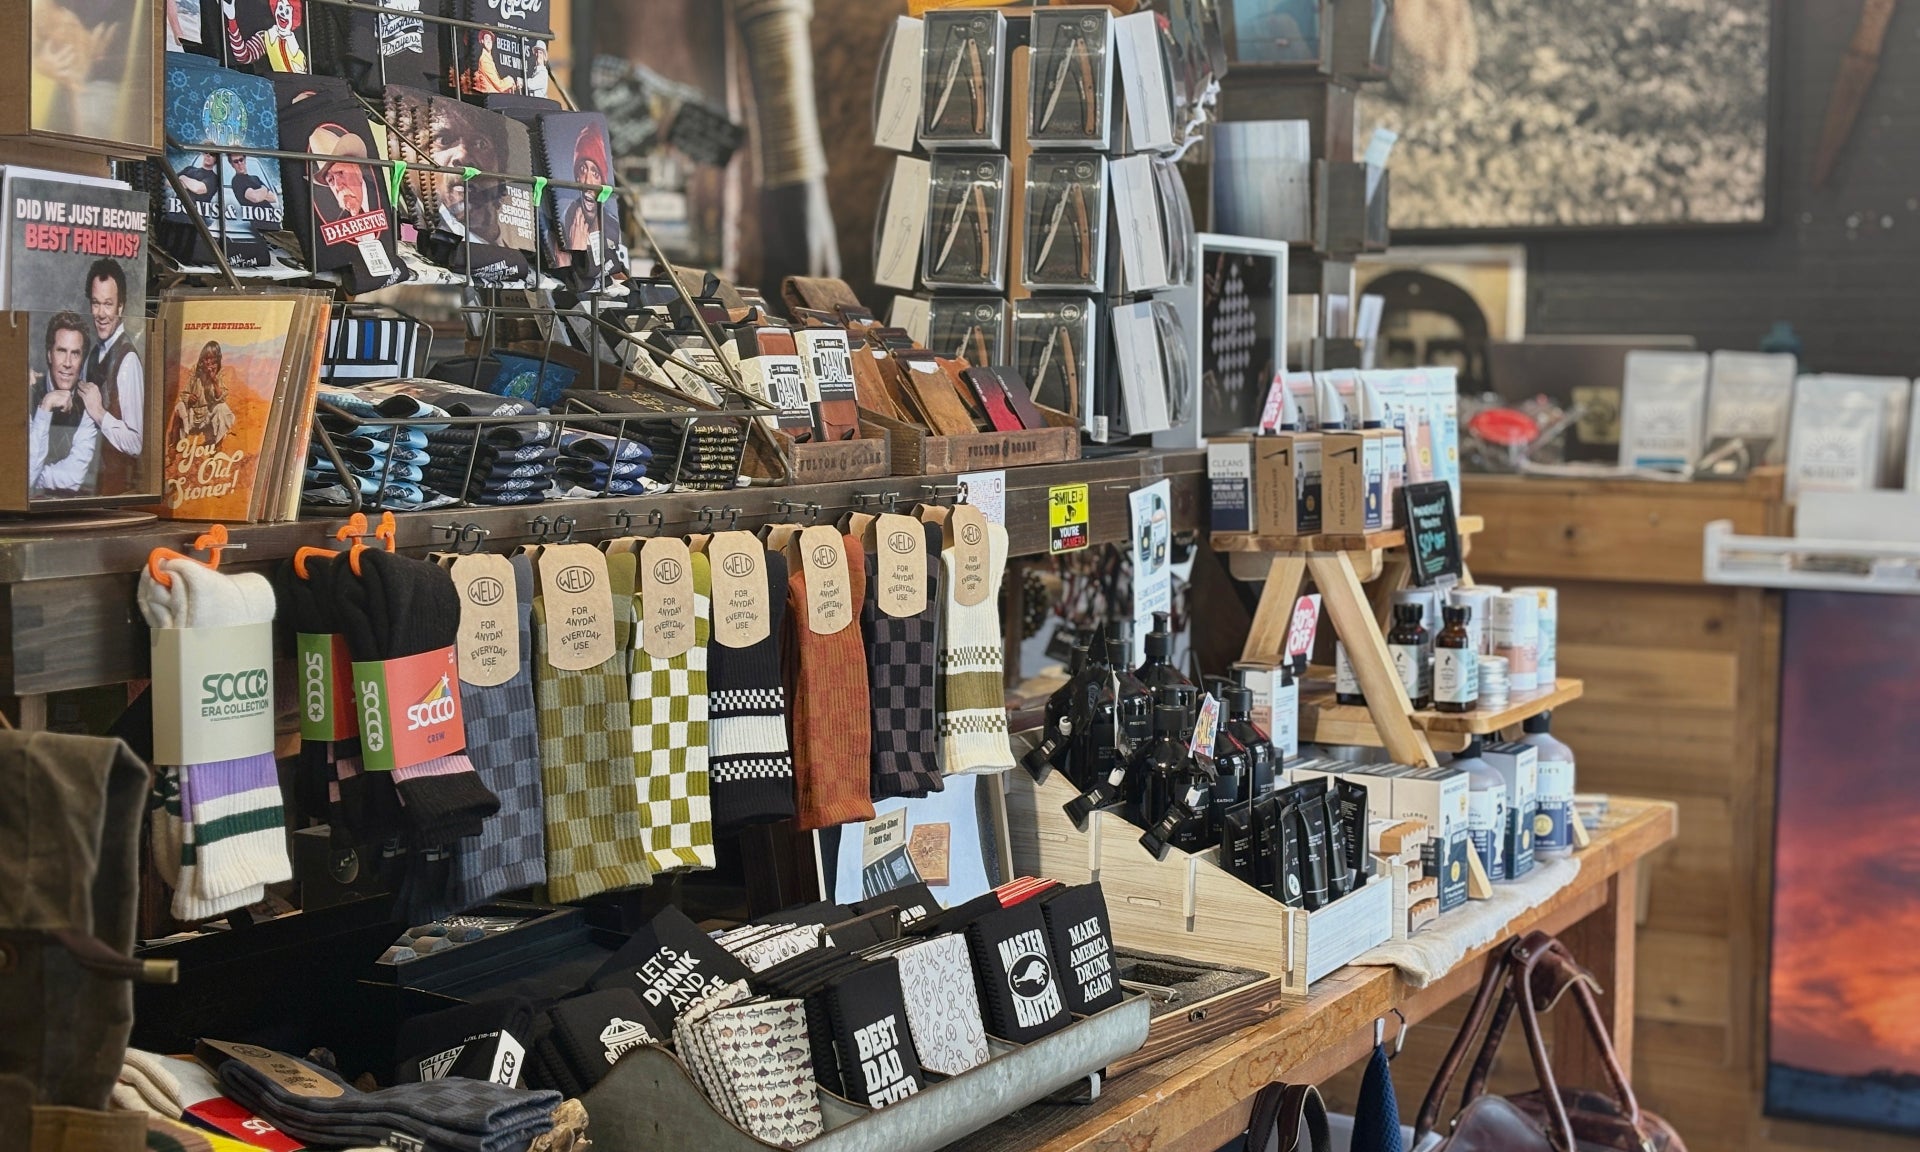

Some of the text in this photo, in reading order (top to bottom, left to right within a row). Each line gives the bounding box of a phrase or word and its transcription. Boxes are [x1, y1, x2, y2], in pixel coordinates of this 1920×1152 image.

[506, 186, 531, 200] THIS IS
[511, 196, 531, 209] SOME
[16, 198, 148, 231] DID WE JUST BECOME
[241, 205, 282, 223] HOES
[502, 205, 531, 220] SERIOUS
[324, 212, 387, 241] DIABEETUS
[498, 213, 532, 229] GOURMET
[25, 223, 141, 257] BEST FRIENDS?
[517, 227, 532, 240] SHIT
[184, 323, 212, 331] HAPPY
[176, 436, 217, 473] You
[968, 444, 999, 457] FULTON
[1012, 441, 1037, 453] ROARK
[198, 450, 244, 485] Old
[800, 458, 837, 471] FULTON
[1212, 459, 1244, 468] CLEANS
[167, 469, 240, 509] Stoner!
[1054, 490, 1077, 506] SMILE!
[889, 534, 914, 551] WELD
[1053, 536, 1086, 550] ON CAMERA
[814, 547, 836, 566] WELD
[656, 561, 680, 581] WELD
[725, 555, 753, 575] WELD
[559, 569, 592, 589] WELD
[823, 580, 834, 588] FOR
[891, 572, 914, 581] ANYDAY
[470, 581, 502, 602] WELD
[734, 590, 748, 598] FOR
[820, 587, 840, 598] ANYDAY
[888, 584, 917, 594] EVERYDAY
[663, 598, 676, 606] FOR
[729, 597, 755, 607] ANYDAY
[817, 601, 843, 614] EVERYDAY
[571, 606, 588, 615] FOR
[658, 606, 682, 616] ANYDAY
[725, 611, 759, 624] EVERYDAY
[824, 610, 835, 618] USE
[480, 620, 496, 629] FOR
[565, 613, 597, 626] ANYDAY
[654, 620, 685, 633] EVERYDAY
[735, 622, 749, 630] USE
[475, 629, 503, 642] ANYDAY
[561, 630, 601, 645] EVERYDAY
[663, 631, 676, 639] USE
[1289, 629, 1311, 652] OFF
[471, 645, 508, 660] EVERYDAY
[573, 641, 590, 650] USE
[482, 657, 497, 666] USE
[201, 669, 269, 704] SOCCO
[306, 651, 325, 722] SOCCO
[201, 706, 222, 718] ERA
[223, 699, 269, 715] COLLECTION
[361, 680, 384, 752] SOCCO
[407, 696, 455, 731] SOCCO
[427, 731, 446, 744] CREW
[868, 818, 899, 836] Tequila Shot
[883, 832, 892, 843] Set
[1068, 916, 1101, 947] MAKE
[998, 929, 1048, 974] MASTER
[1070, 935, 1110, 968] AMERICA
[635, 946, 677, 985] LET'S
[1075, 953, 1112, 985] DRUNK
[642, 950, 701, 1007] DRINK
[669, 972, 705, 1012] AND
[1084, 972, 1113, 1003] AGAIN
[1012, 979, 1063, 1028] BAITER
[853, 1014, 899, 1062] BEST
[421, 1048, 461, 1068] VALLELY
[861, 1048, 904, 1094] DAD
